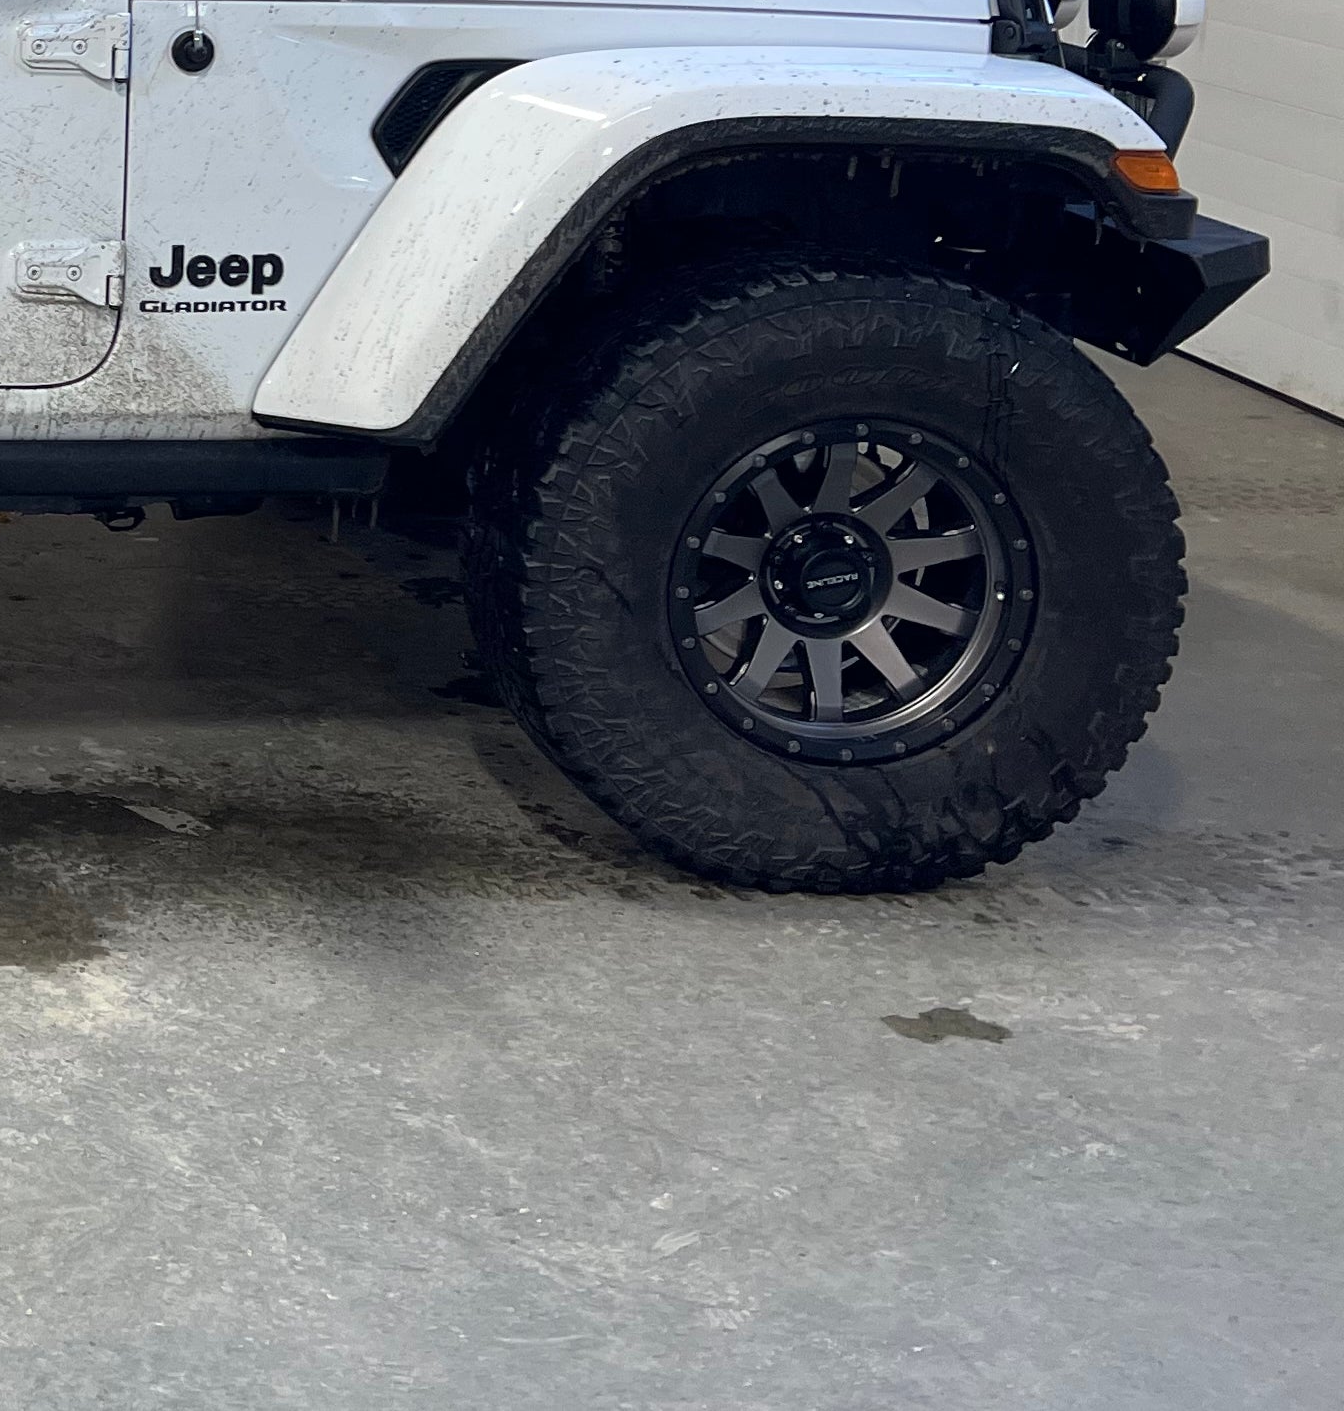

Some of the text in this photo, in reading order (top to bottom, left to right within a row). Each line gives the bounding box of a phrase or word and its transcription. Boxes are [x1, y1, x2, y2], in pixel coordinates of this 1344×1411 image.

[149, 245, 284, 295] Jeep
[139, 300, 288, 313] GLADIATOR
[806, 573, 858, 589] RACELINE
